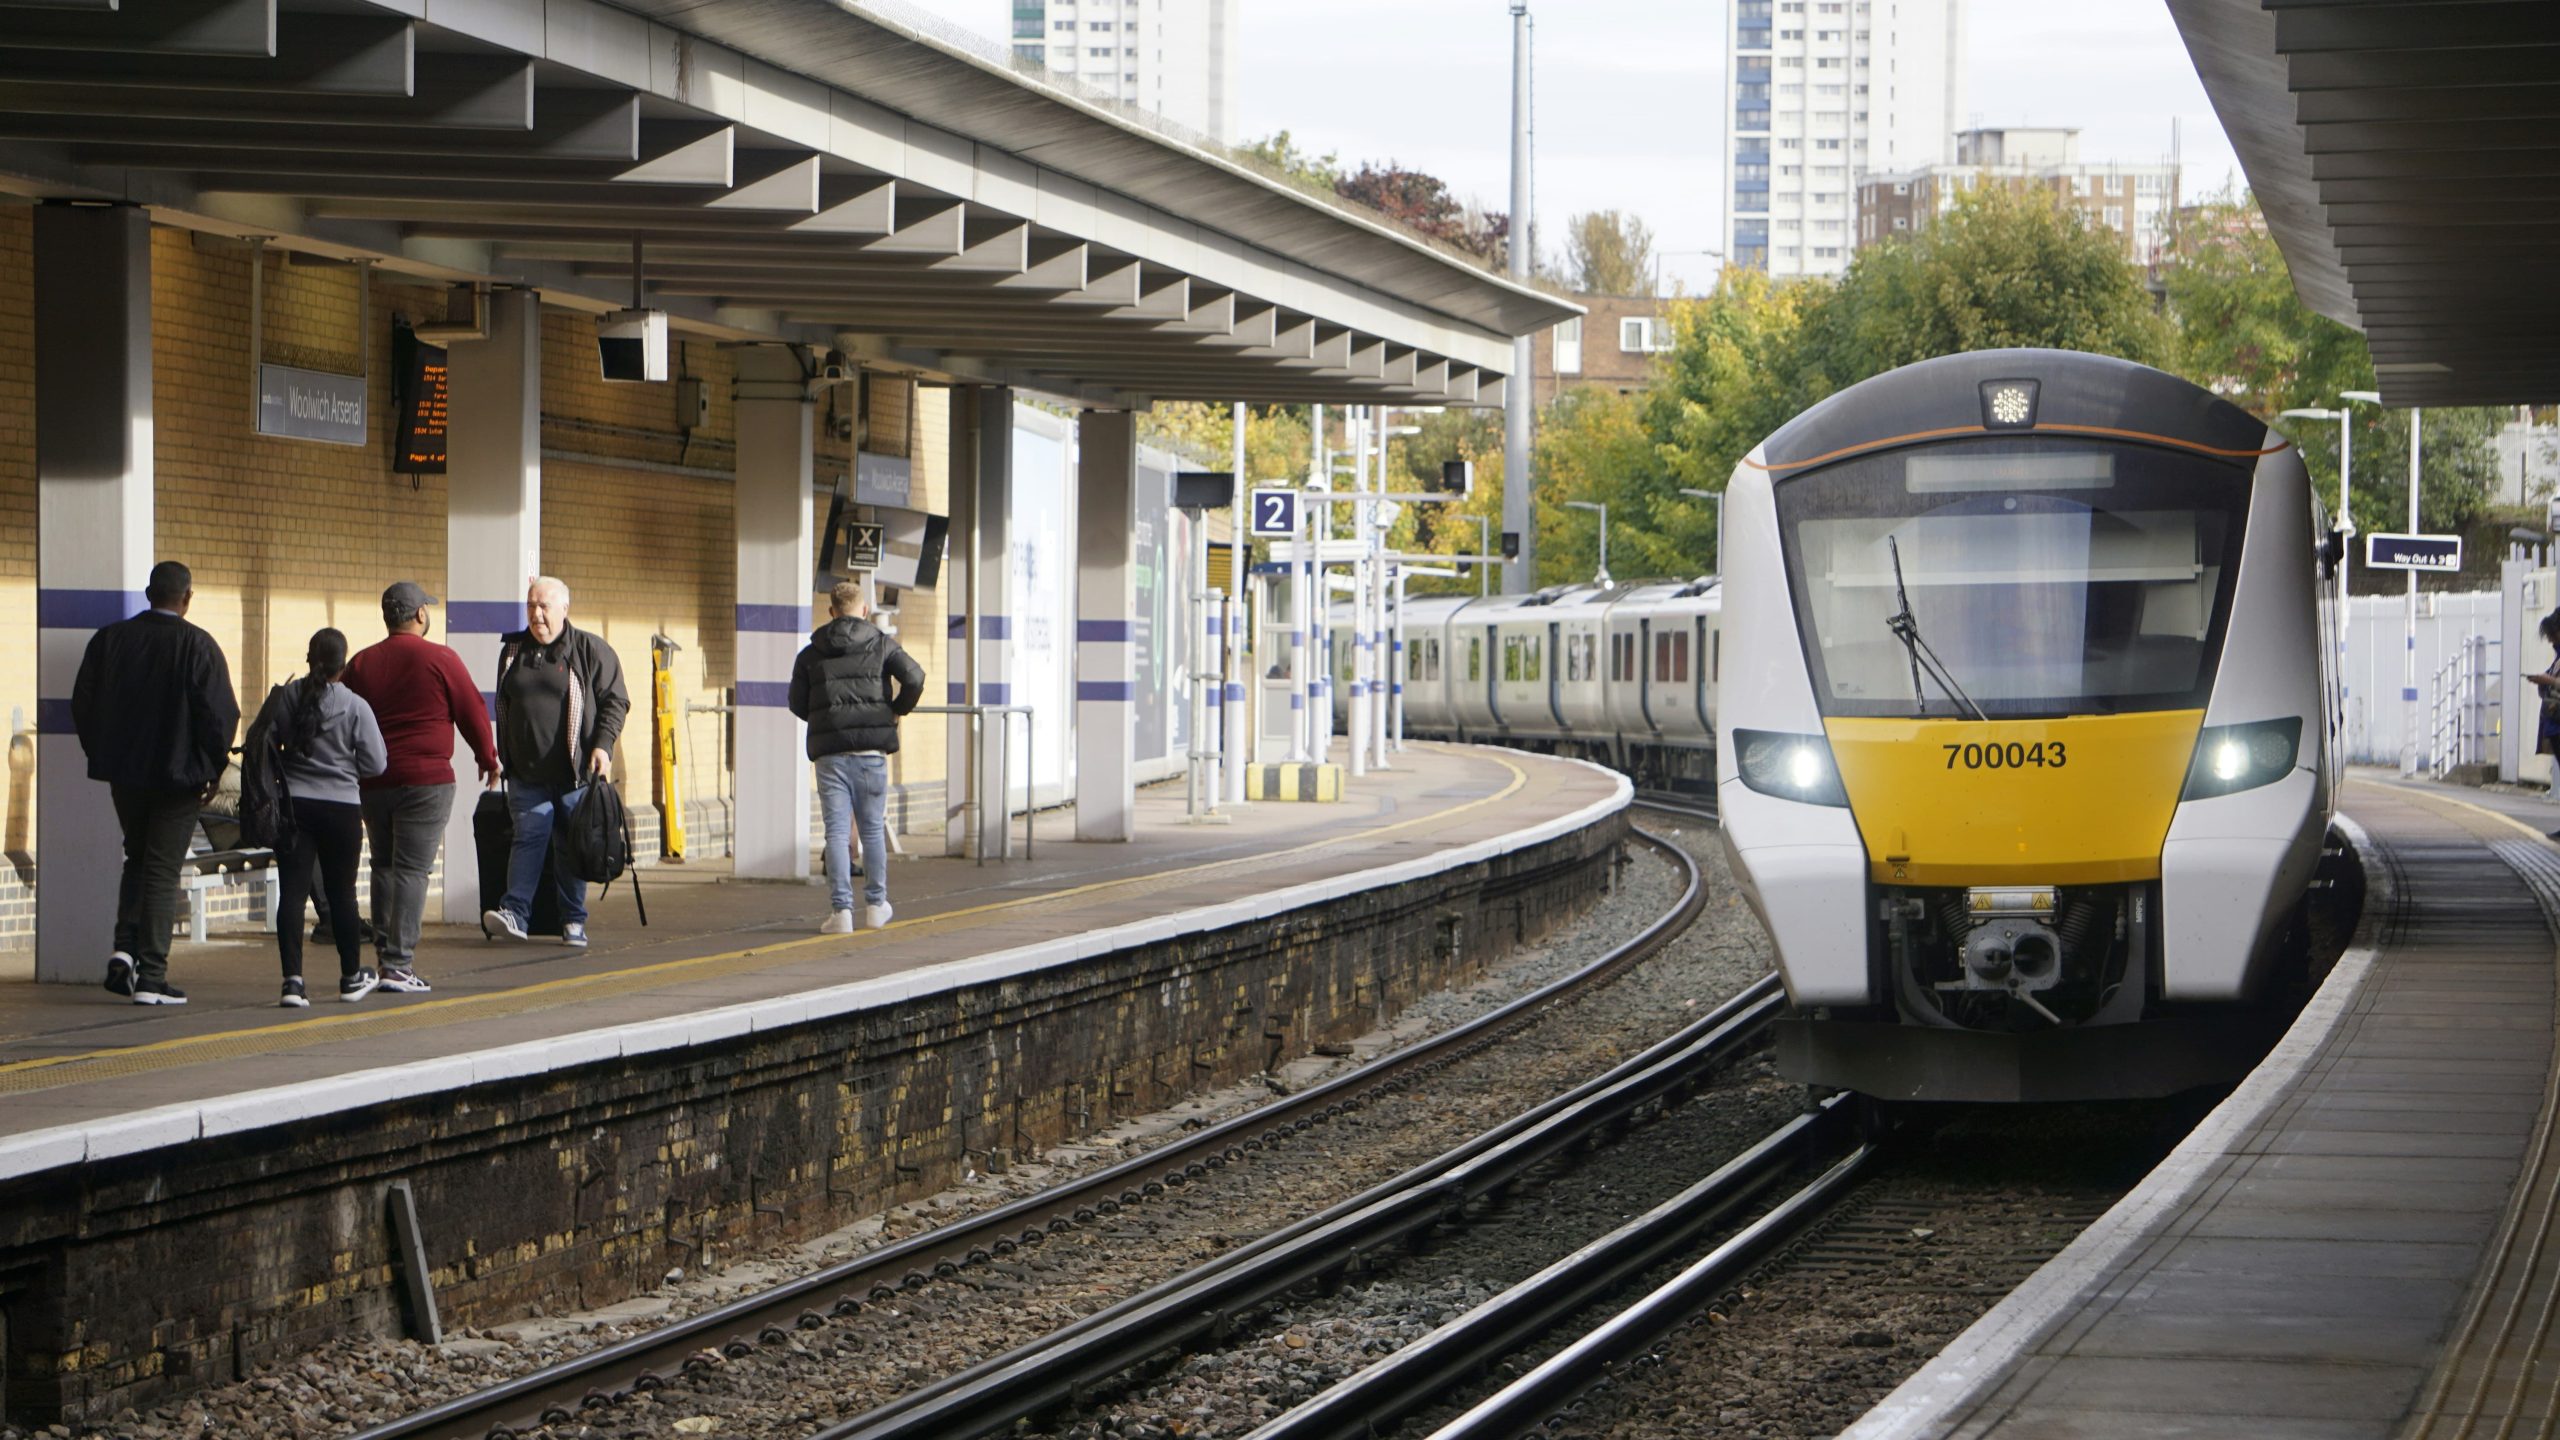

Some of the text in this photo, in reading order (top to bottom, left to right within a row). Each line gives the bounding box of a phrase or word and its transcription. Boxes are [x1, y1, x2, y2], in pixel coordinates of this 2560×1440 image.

[289, 385, 361, 425] Woolwich Arsenal
[410, 453, 427, 462] Page
[1264, 496, 1285, 528] 2
[858, 527, 873, 546] X
[2394, 552, 2427, 564] Way Out
[1942, 741, 2067, 770] 700043
